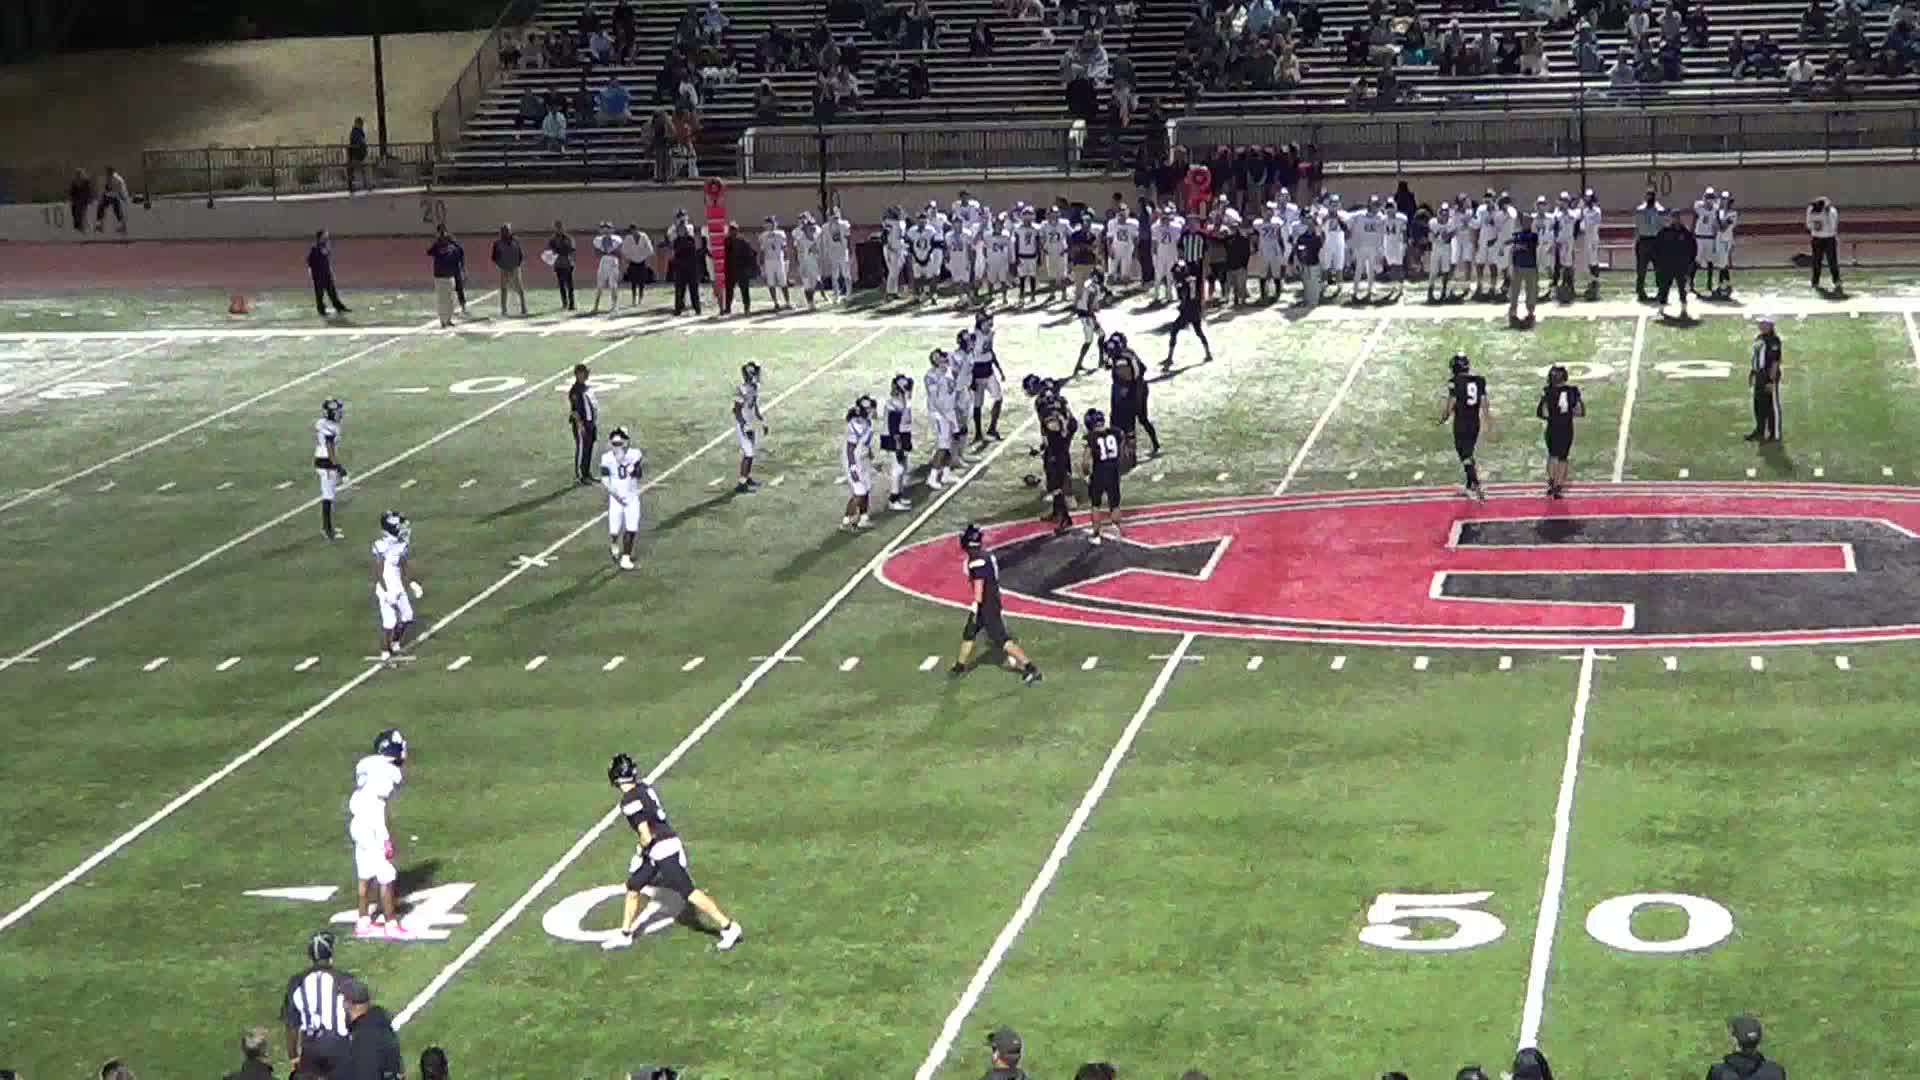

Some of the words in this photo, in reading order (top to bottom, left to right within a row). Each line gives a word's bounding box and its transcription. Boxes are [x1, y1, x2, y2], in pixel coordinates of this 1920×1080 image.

[420, 199, 447, 223] 20
[1466, 382, 1478, 406] 9
[1558, 391, 1569, 414] 4
[1097, 434, 1118, 461] 19
[1358, 890, 1734, 953] 50
